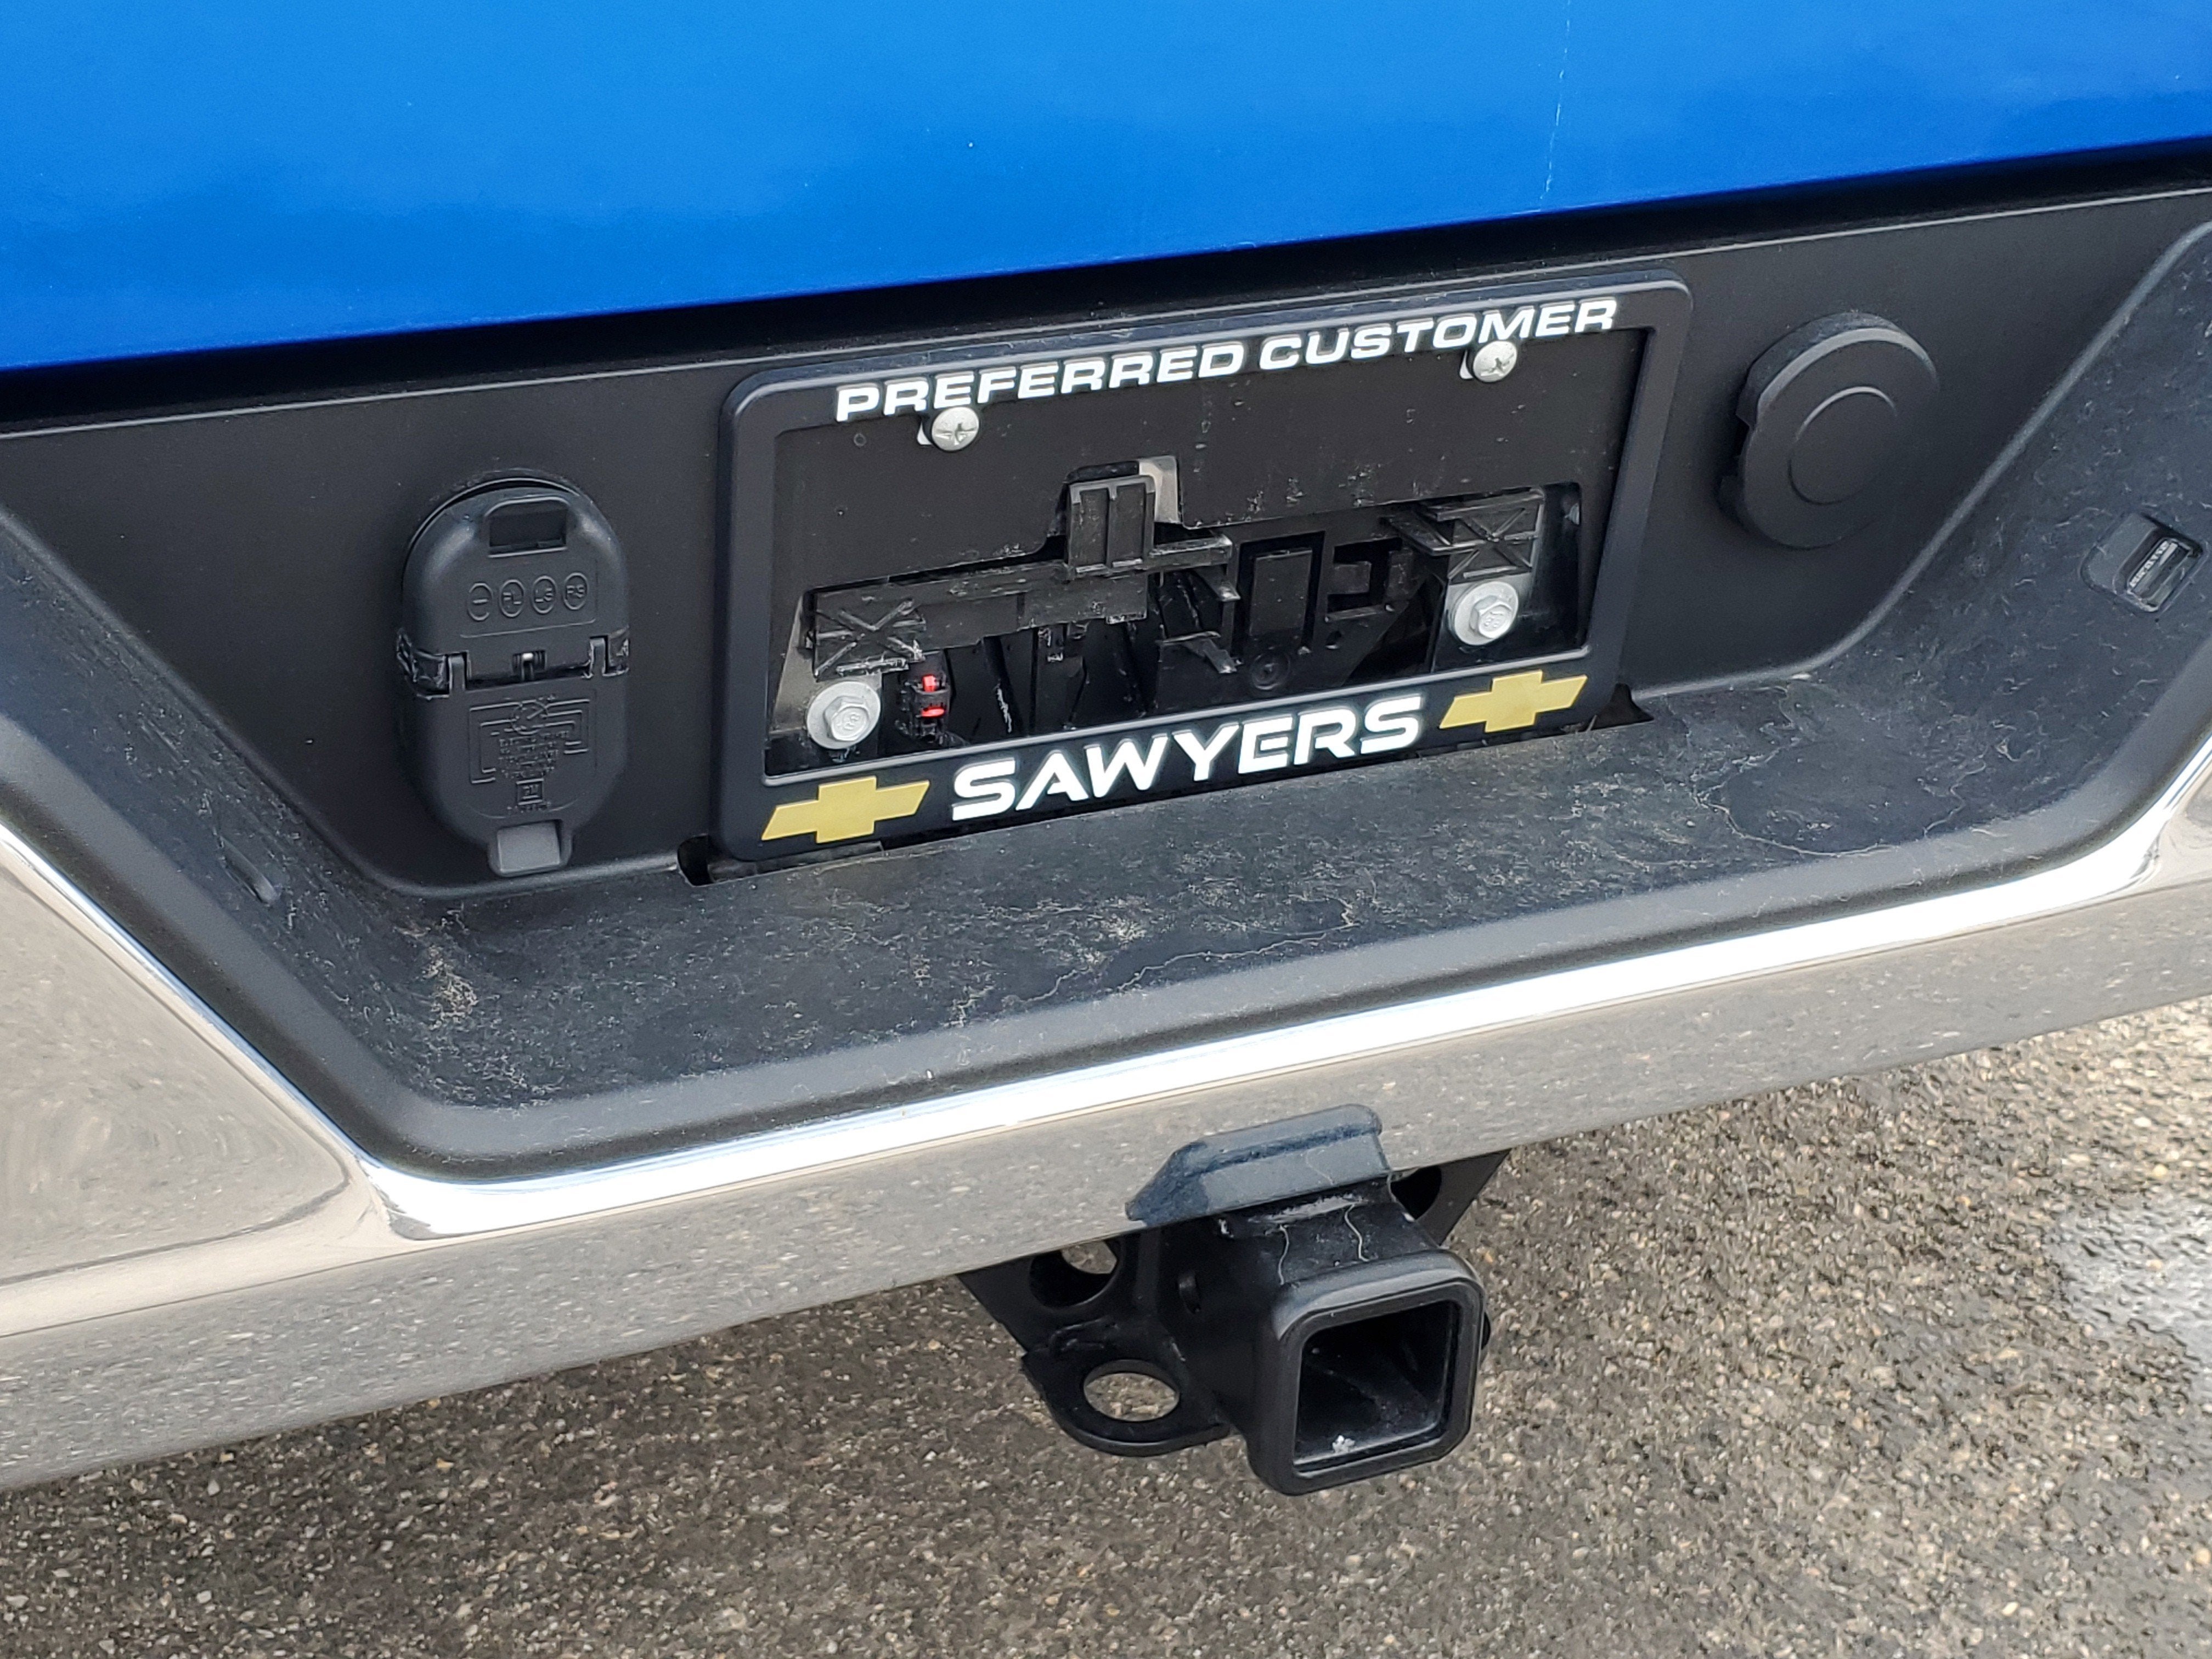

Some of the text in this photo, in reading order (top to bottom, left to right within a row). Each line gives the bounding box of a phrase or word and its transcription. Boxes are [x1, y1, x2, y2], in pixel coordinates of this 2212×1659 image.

[835, 297, 1618, 422] PREFERRED CUSTOMER
[952, 693, 1423, 822] SAWYERS
